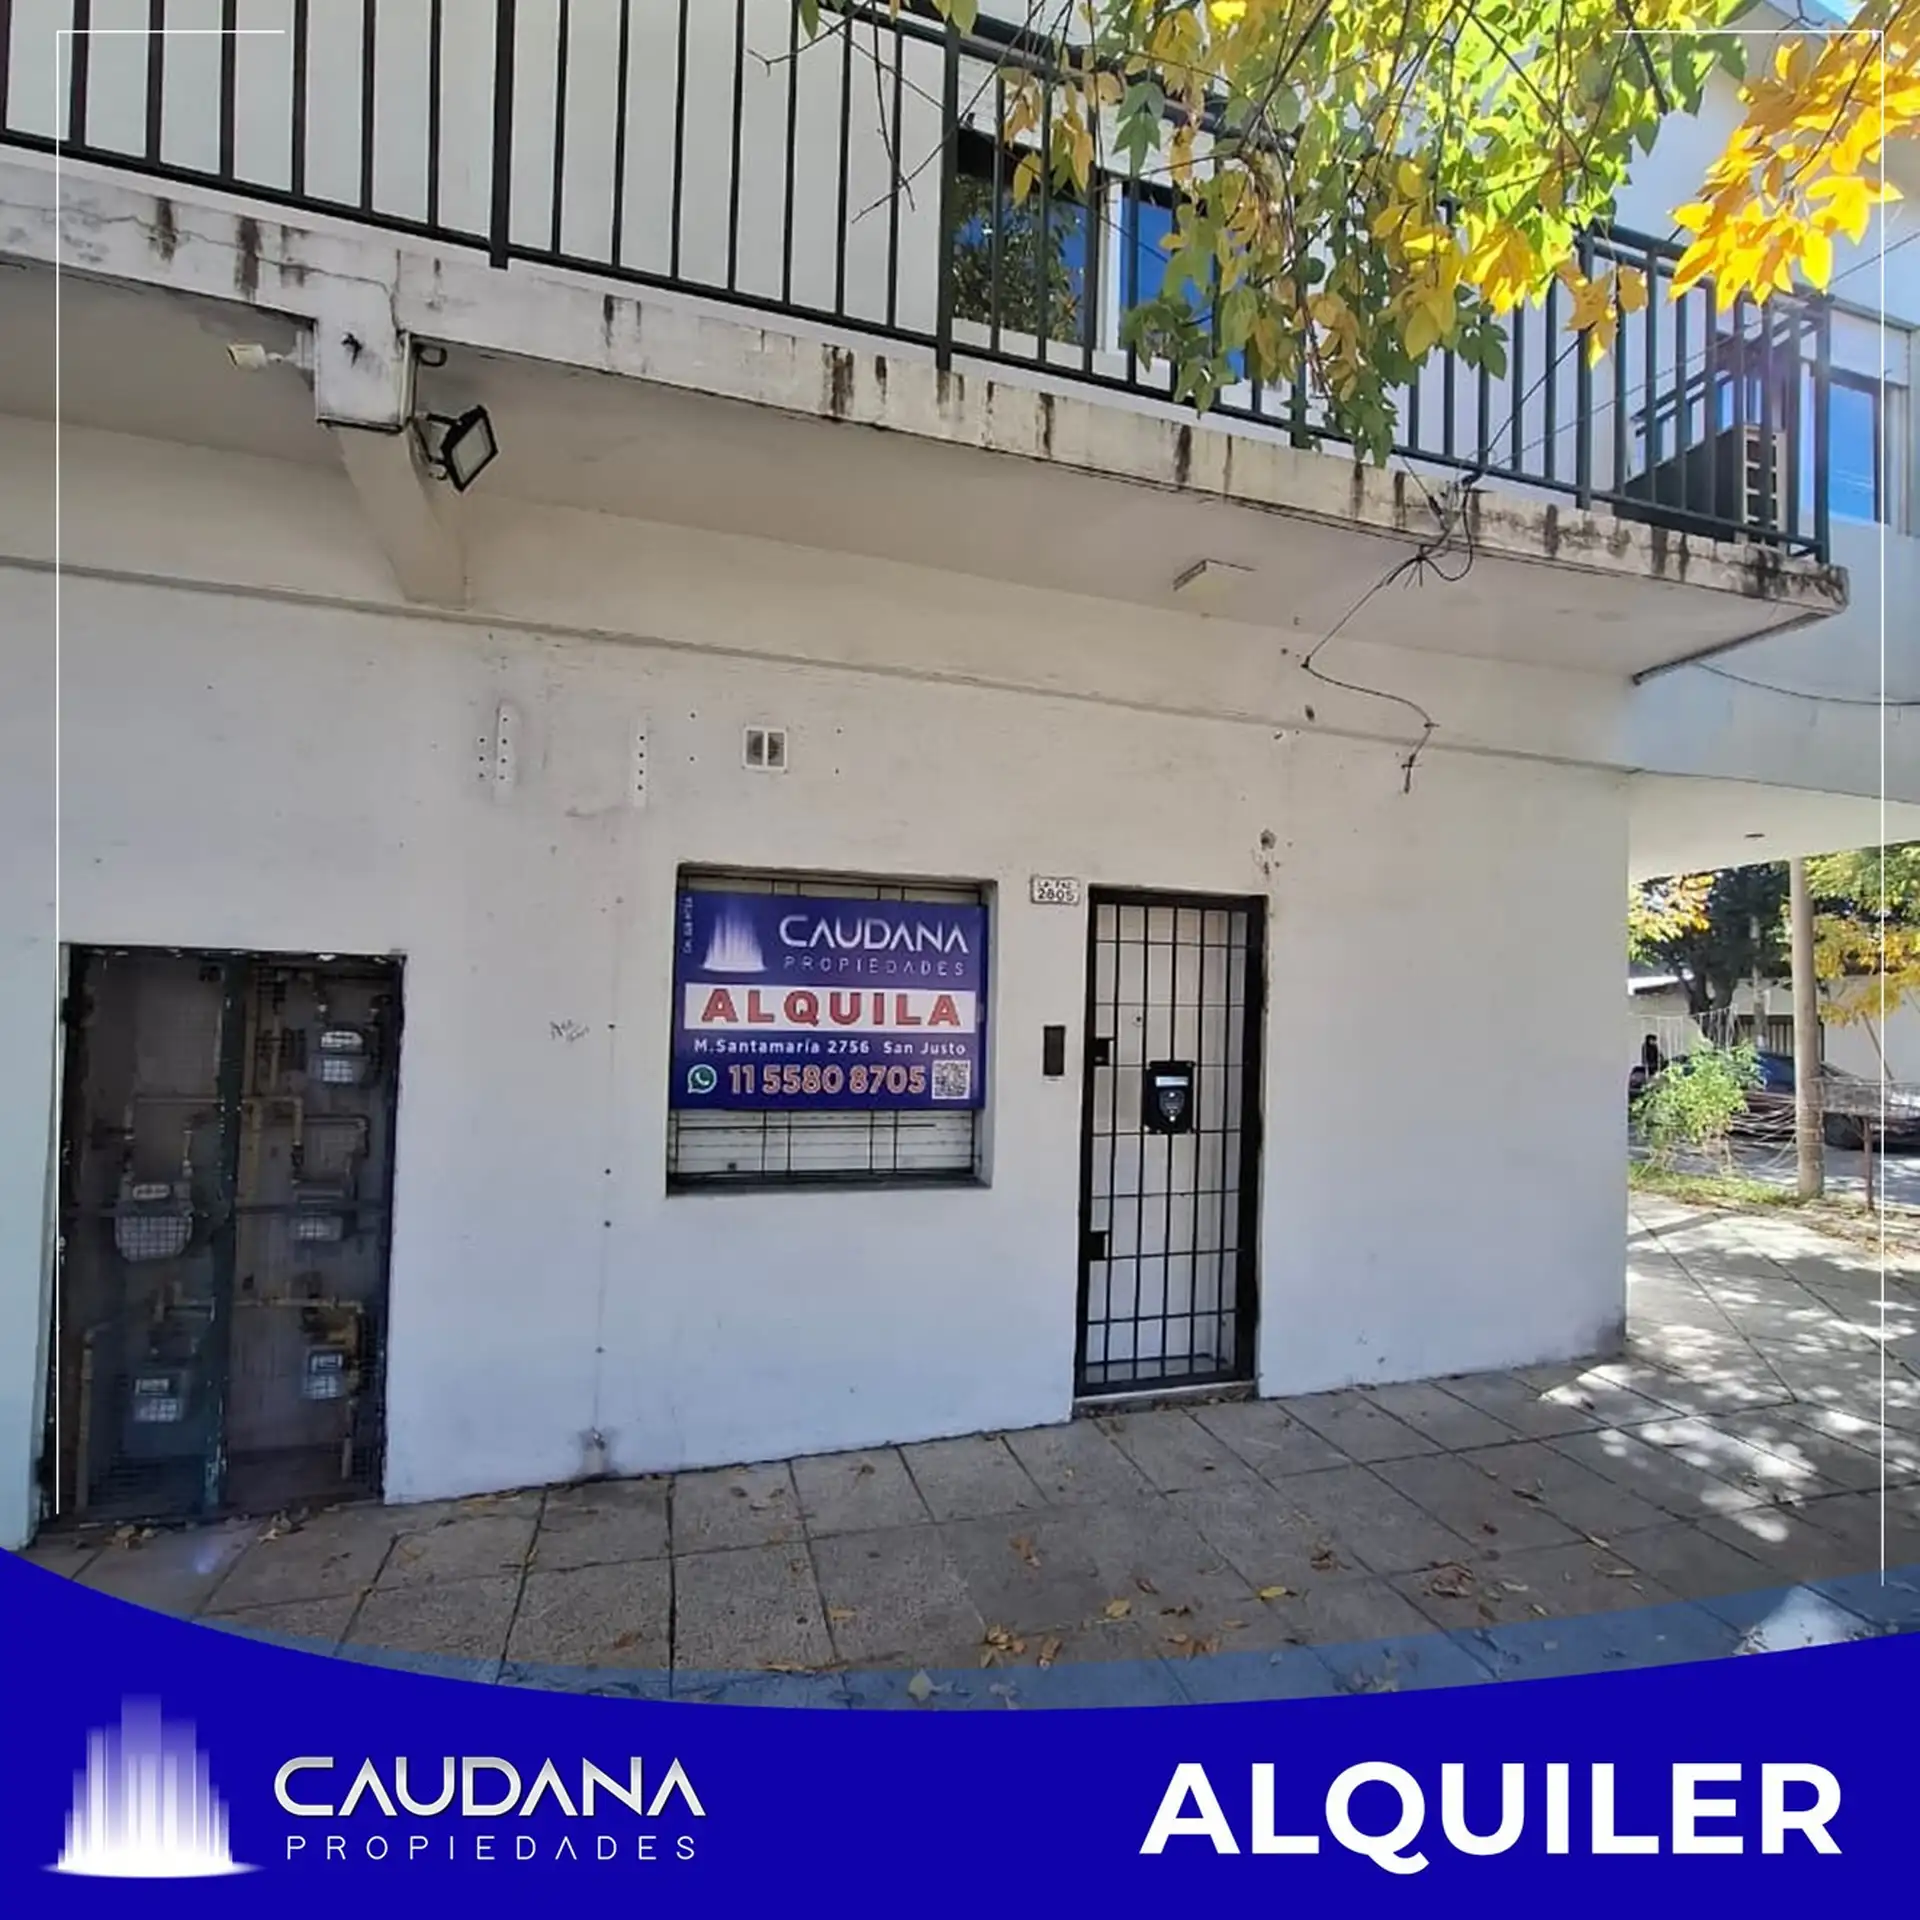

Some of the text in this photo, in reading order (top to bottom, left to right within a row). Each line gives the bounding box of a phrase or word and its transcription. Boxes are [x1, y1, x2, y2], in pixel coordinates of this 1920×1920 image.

[1037, 887, 1076, 902] 2805
[779, 914, 970, 954] CAUDANA
[783, 955, 965, 976] PROPIEDADES
[701, 988, 961, 1027] ALQUILA
[827, 1039, 870, 1054] 2756
[883, 1041, 914, 1055] San
[920, 1041, 967, 1056] Justo
[728, 1064, 927, 1094] 11 5580 8705
